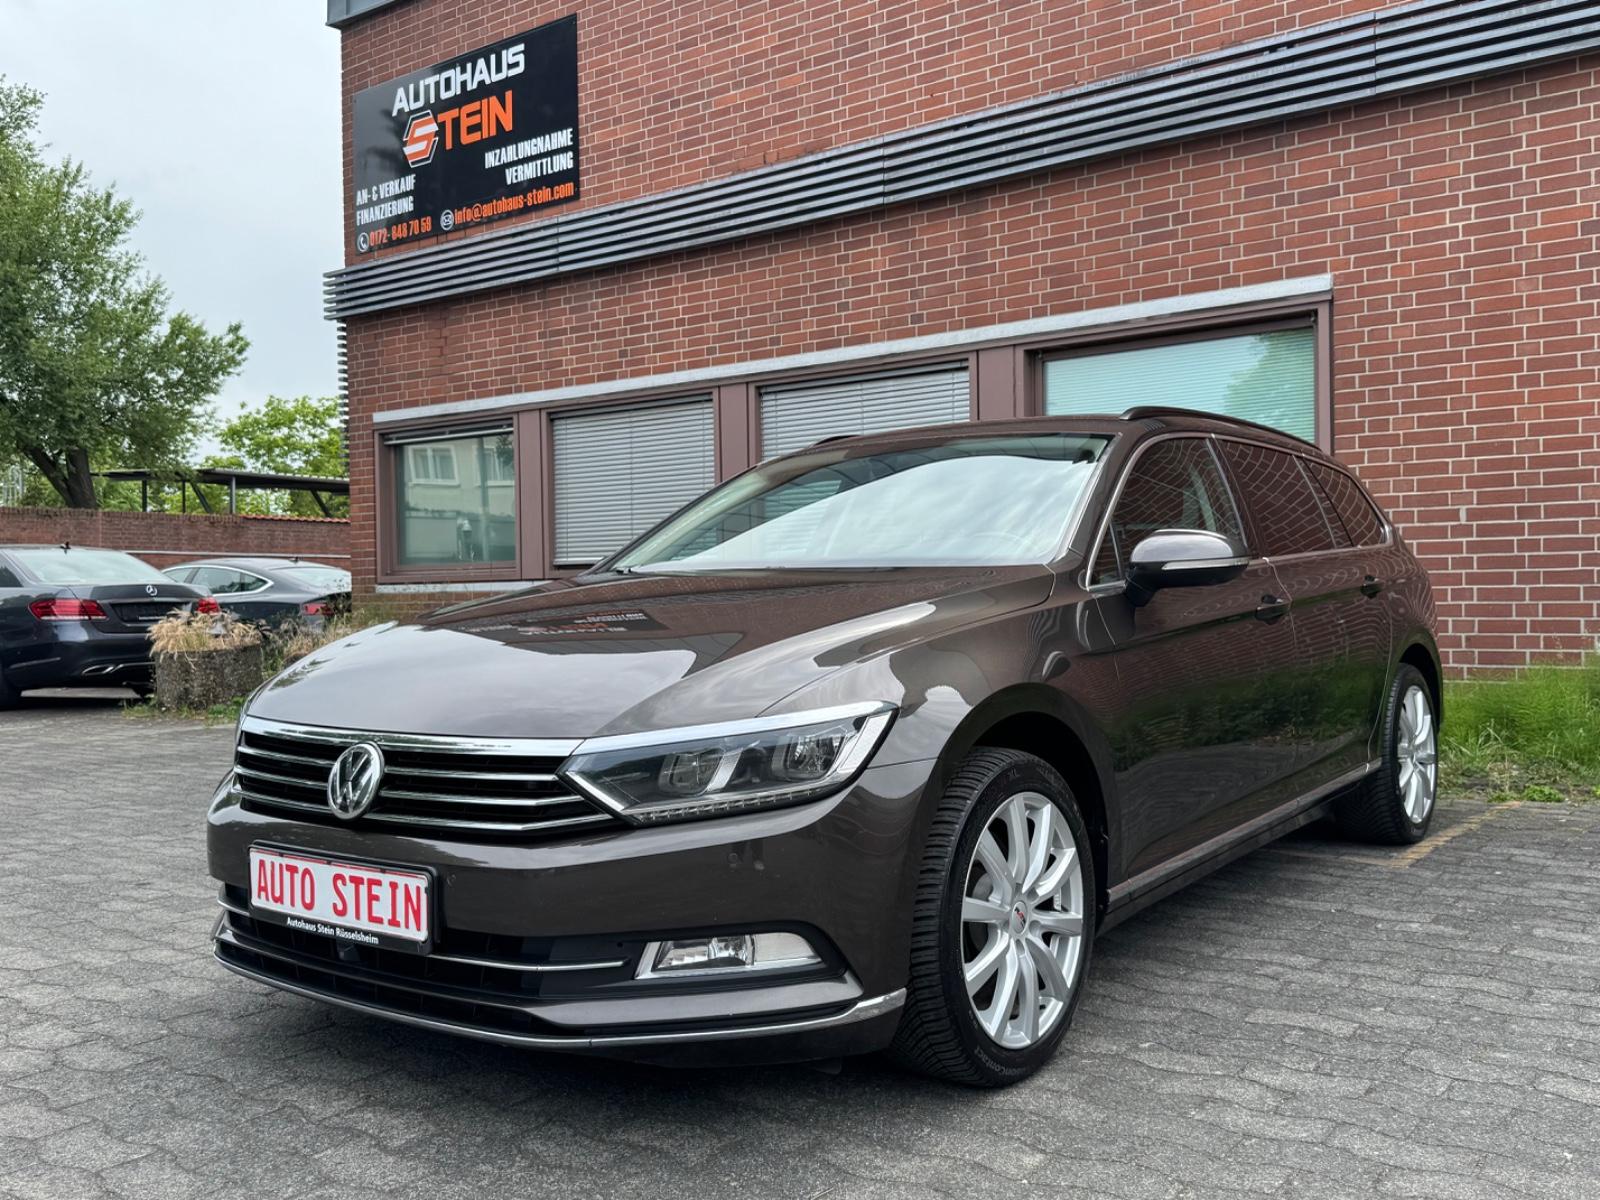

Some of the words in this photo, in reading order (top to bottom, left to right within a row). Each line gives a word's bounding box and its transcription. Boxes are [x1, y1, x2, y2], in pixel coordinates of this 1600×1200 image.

[392, 43, 525, 117] AUTOHAUS
[485, 127, 573, 169] INZAHLUNGNAHME
[372, 185, 378, 201] &
[379, 173, 416, 199] VERKAUF
[505, 151, 574, 185] VERMITTLUNG
[356, 195, 414, 226] FINANZIERUNG
[454, 182, 574, 224] info@autohaus-stein.com
[257, 859, 316, 911] AUTO
[332, 873, 422, 932] STEIN
[287, 917, 317, 931] Autohaus
[317, 923, 334, 936] Stein
[335, 927, 379, 944] Rüsselsheim
